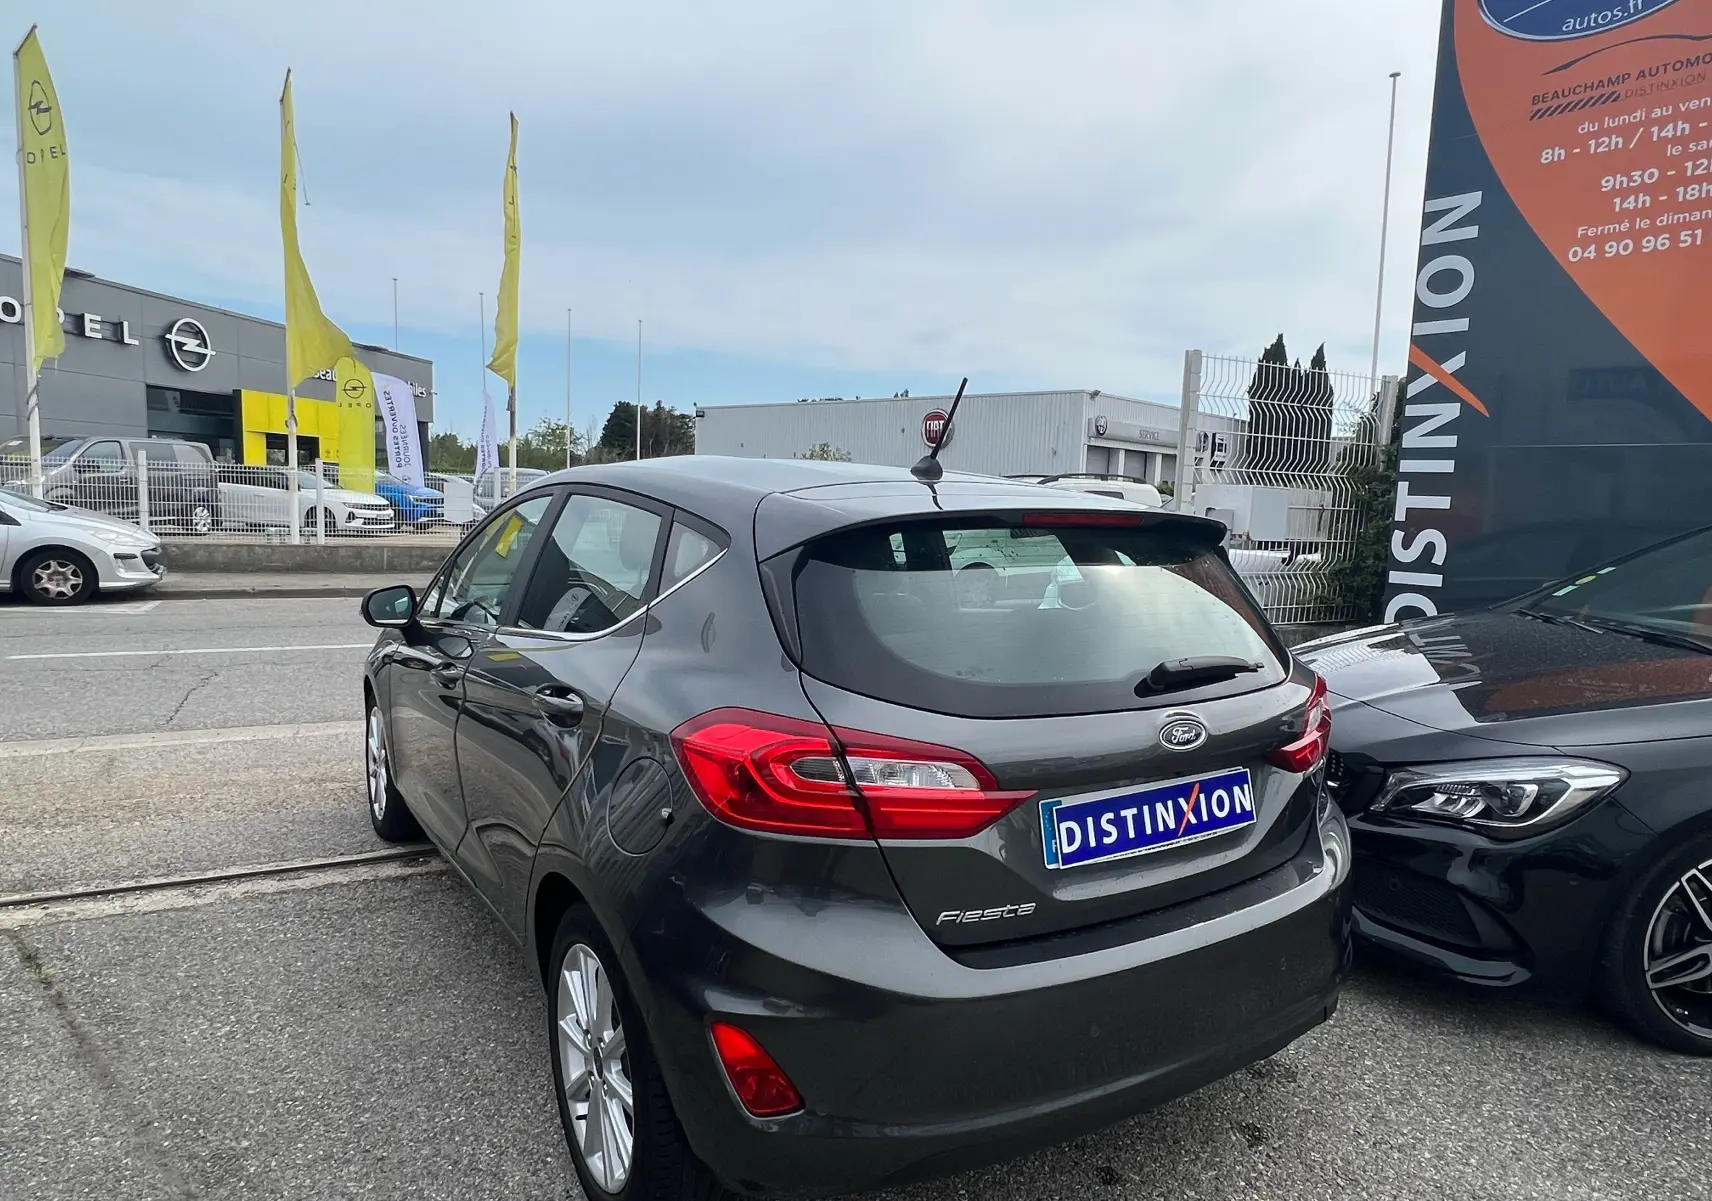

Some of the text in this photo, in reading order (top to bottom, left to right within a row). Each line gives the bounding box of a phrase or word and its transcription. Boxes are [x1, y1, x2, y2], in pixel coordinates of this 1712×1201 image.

[1562, 0, 1645, 32] autos.fr
[1531, 53, 1712, 106] BEAUCHAMP AUTOMO
[1625, 71, 1707, 98] DISTINXION
[1578, 96, 1711, 134] du lundi au ven
[1540, 146, 1566, 164] 8h
[1588, 134, 1624, 154] 12h
[1629, 127, 1644, 149] /
[1650, 120, 1691, 142] 14h
[1666, 144, 1683, 157] le
[1601, 168, 1660, 192] 9h30
[1613, 192, 1651, 213] 14h
[1676, 182, 1712, 202] 18h
[1577, 209, 1712, 239] Fermé le diman
[1568, 228, 1703, 262] 04 90 96 51
[1383, 190, 1489, 625] DISTINXION
[926, 420, 945, 438] FIAT
[1171, 726, 1197, 744] Ford
[1058, 782, 1253, 855] DISTINXION
[935, 902, 1037, 926] Fiesta
